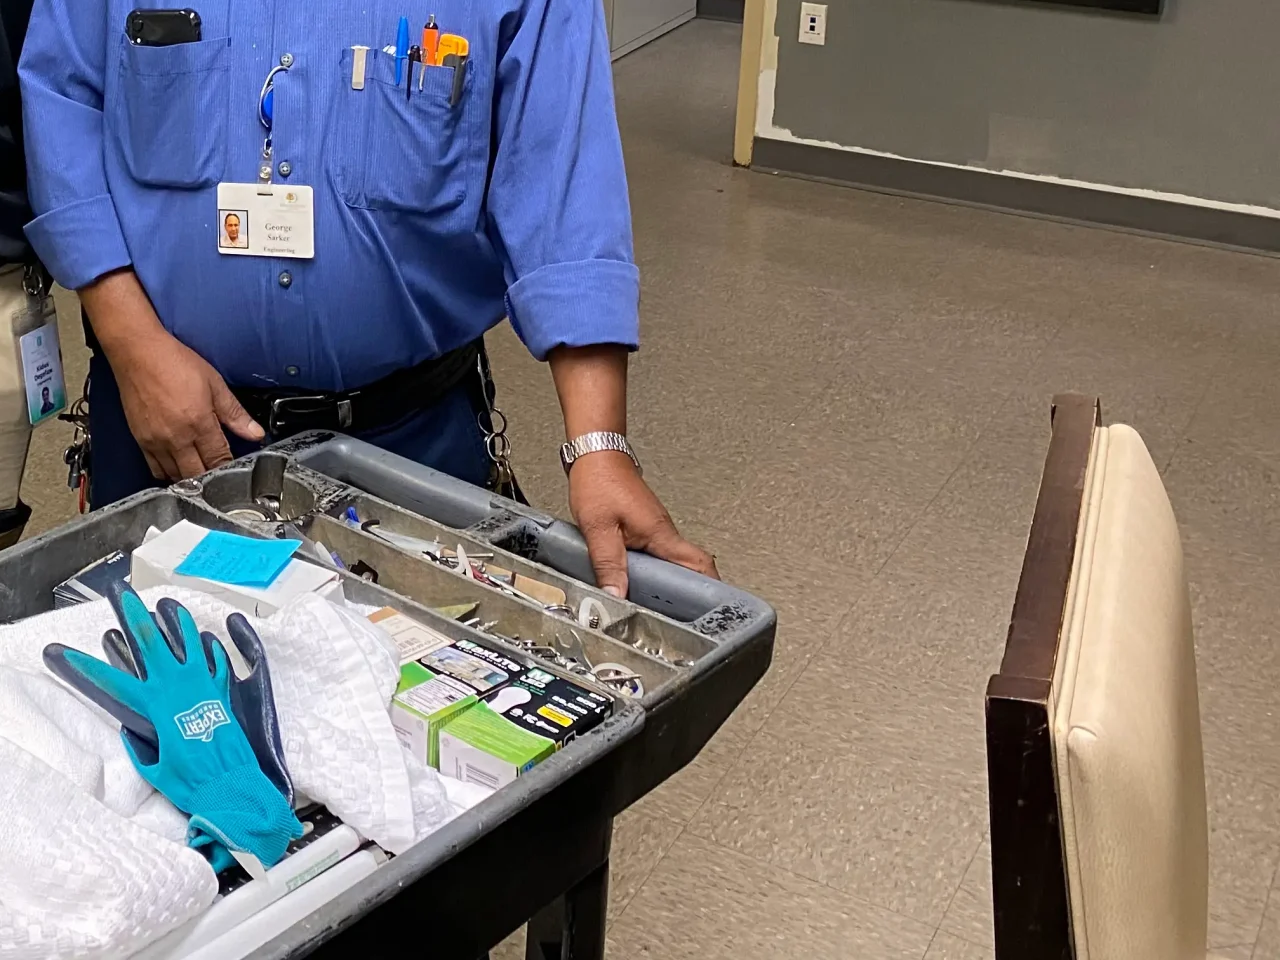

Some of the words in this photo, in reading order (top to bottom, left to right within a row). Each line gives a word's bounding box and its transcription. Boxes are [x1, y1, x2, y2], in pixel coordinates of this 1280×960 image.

[264, 222, 293, 233] George
[266, 234, 291, 242] Sarker
[263, 246, 296, 254] Engineering
[183, 709, 225, 735] EXPERT
